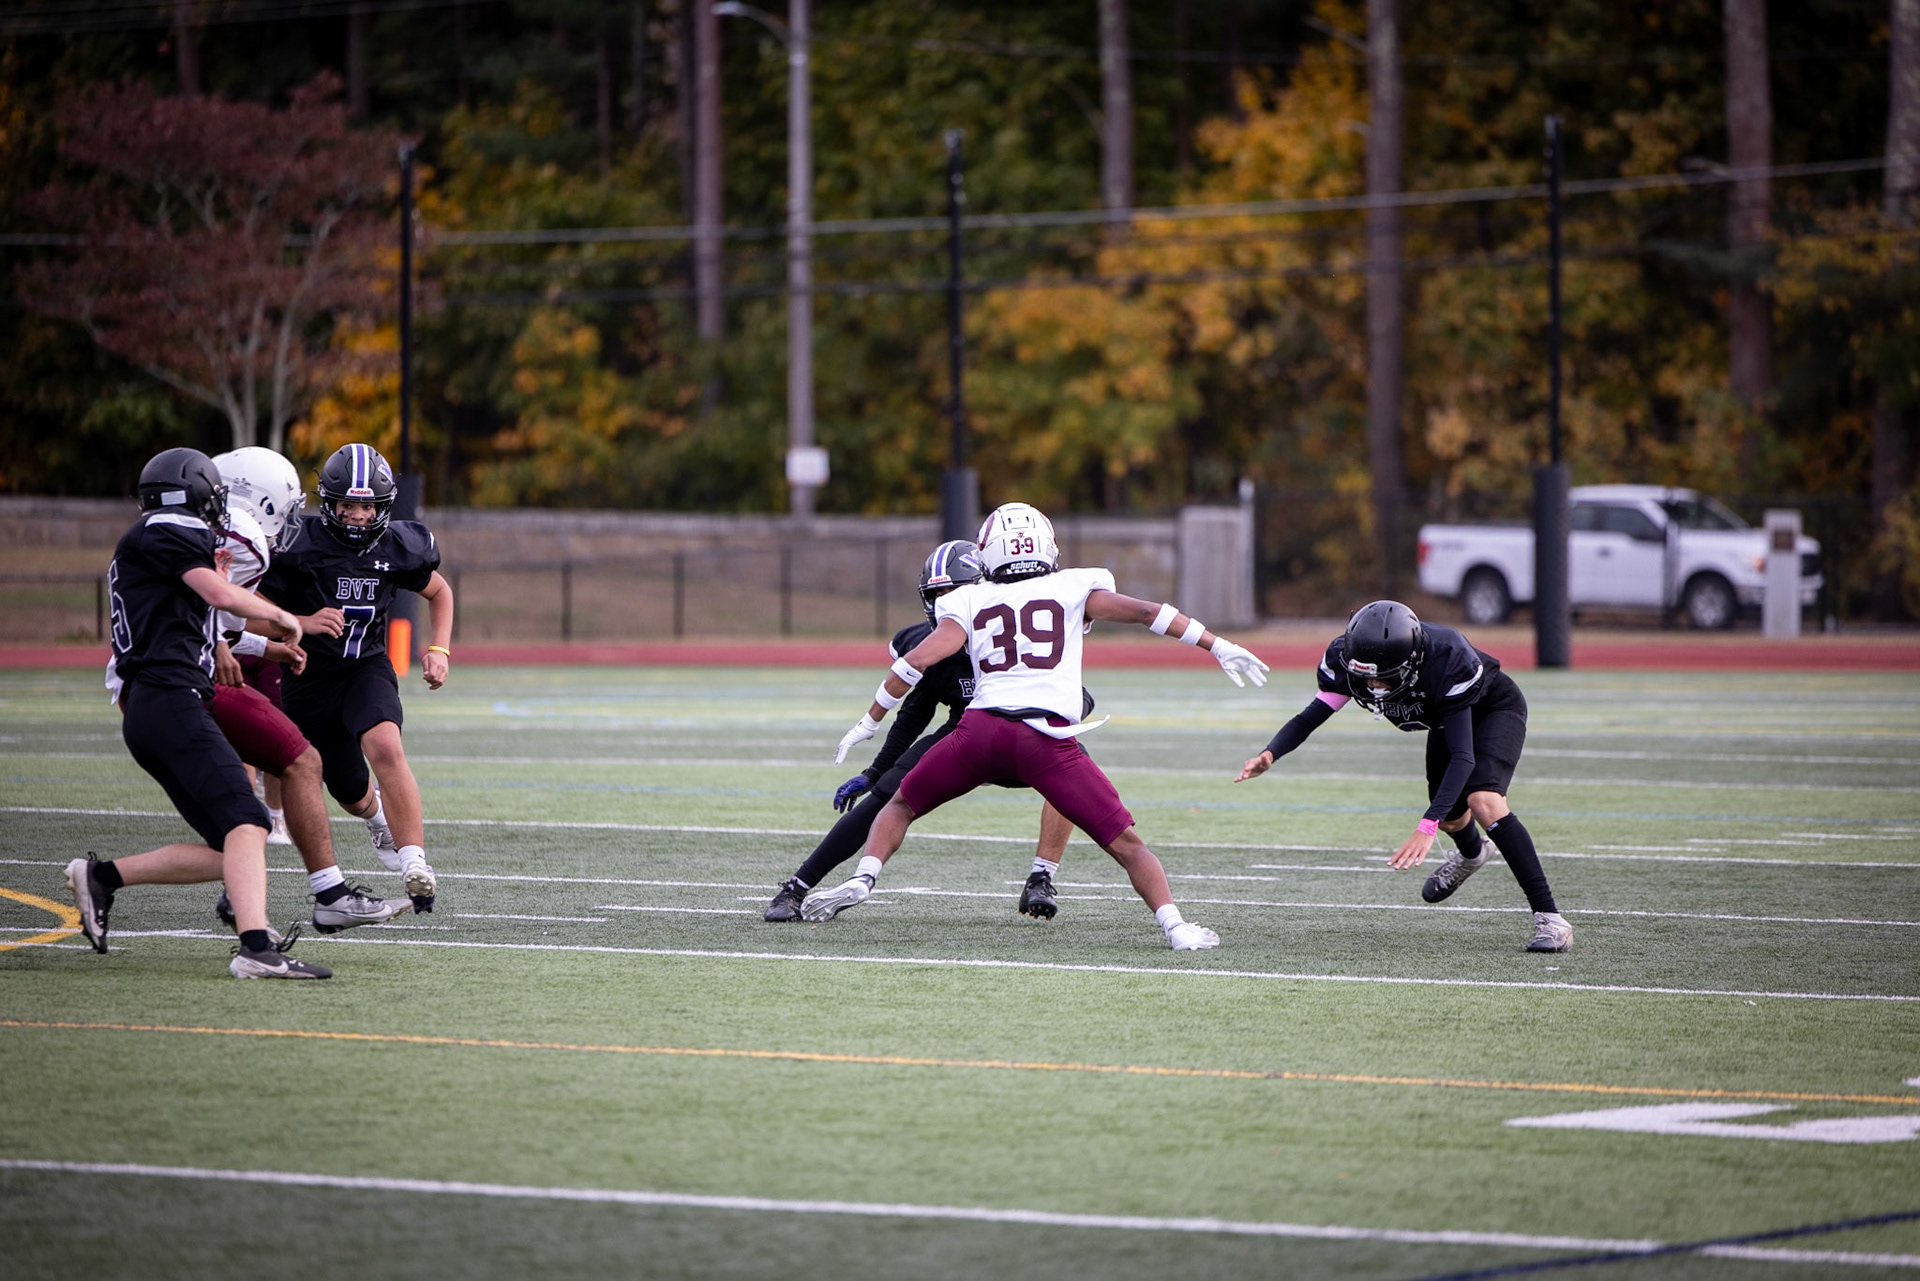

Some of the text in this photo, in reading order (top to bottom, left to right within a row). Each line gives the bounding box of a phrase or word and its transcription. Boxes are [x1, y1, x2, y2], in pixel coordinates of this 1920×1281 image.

[336, 577, 380, 600] BVT
[342, 605, 376, 659] 7
[973, 599, 1065, 674] 39
[1384, 701, 1425, 721] BVT
